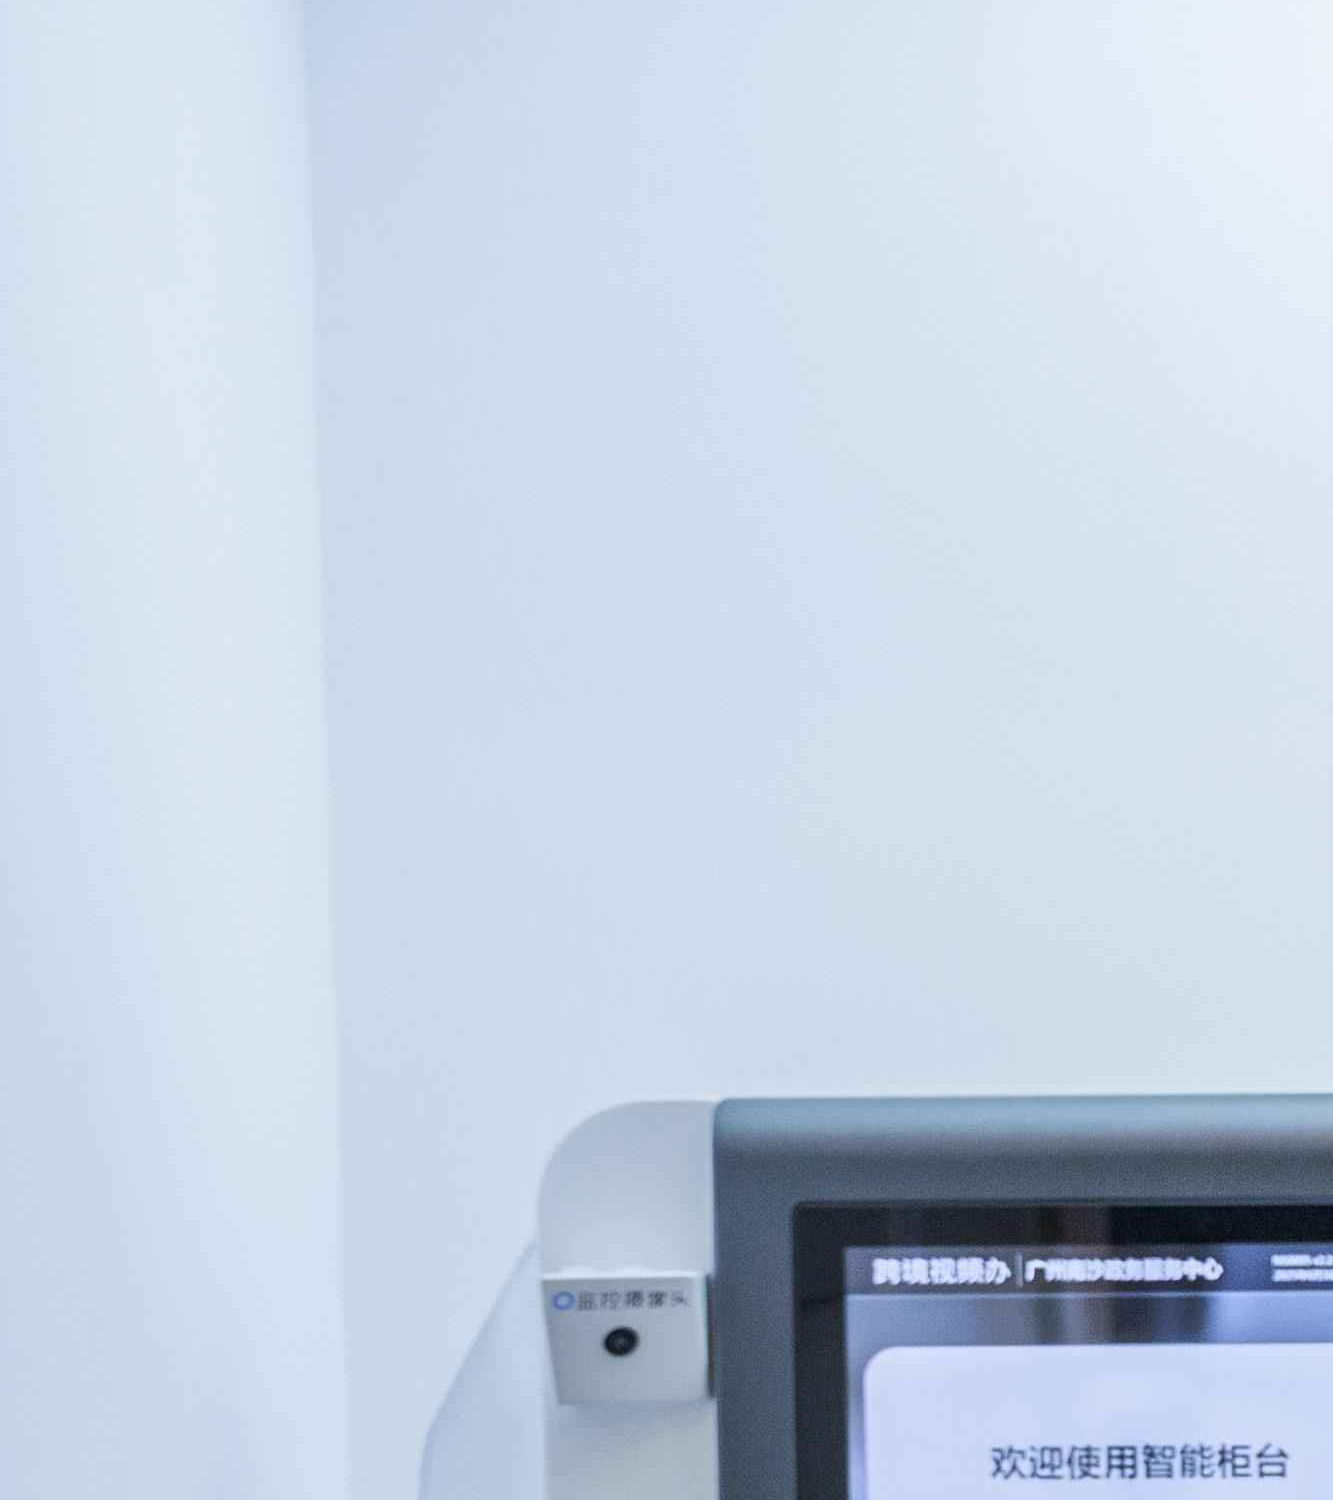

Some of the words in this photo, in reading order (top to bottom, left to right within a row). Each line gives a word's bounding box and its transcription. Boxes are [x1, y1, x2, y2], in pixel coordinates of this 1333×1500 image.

[991, 1443, 1289, 1480] 欢迎使用智能柜台
